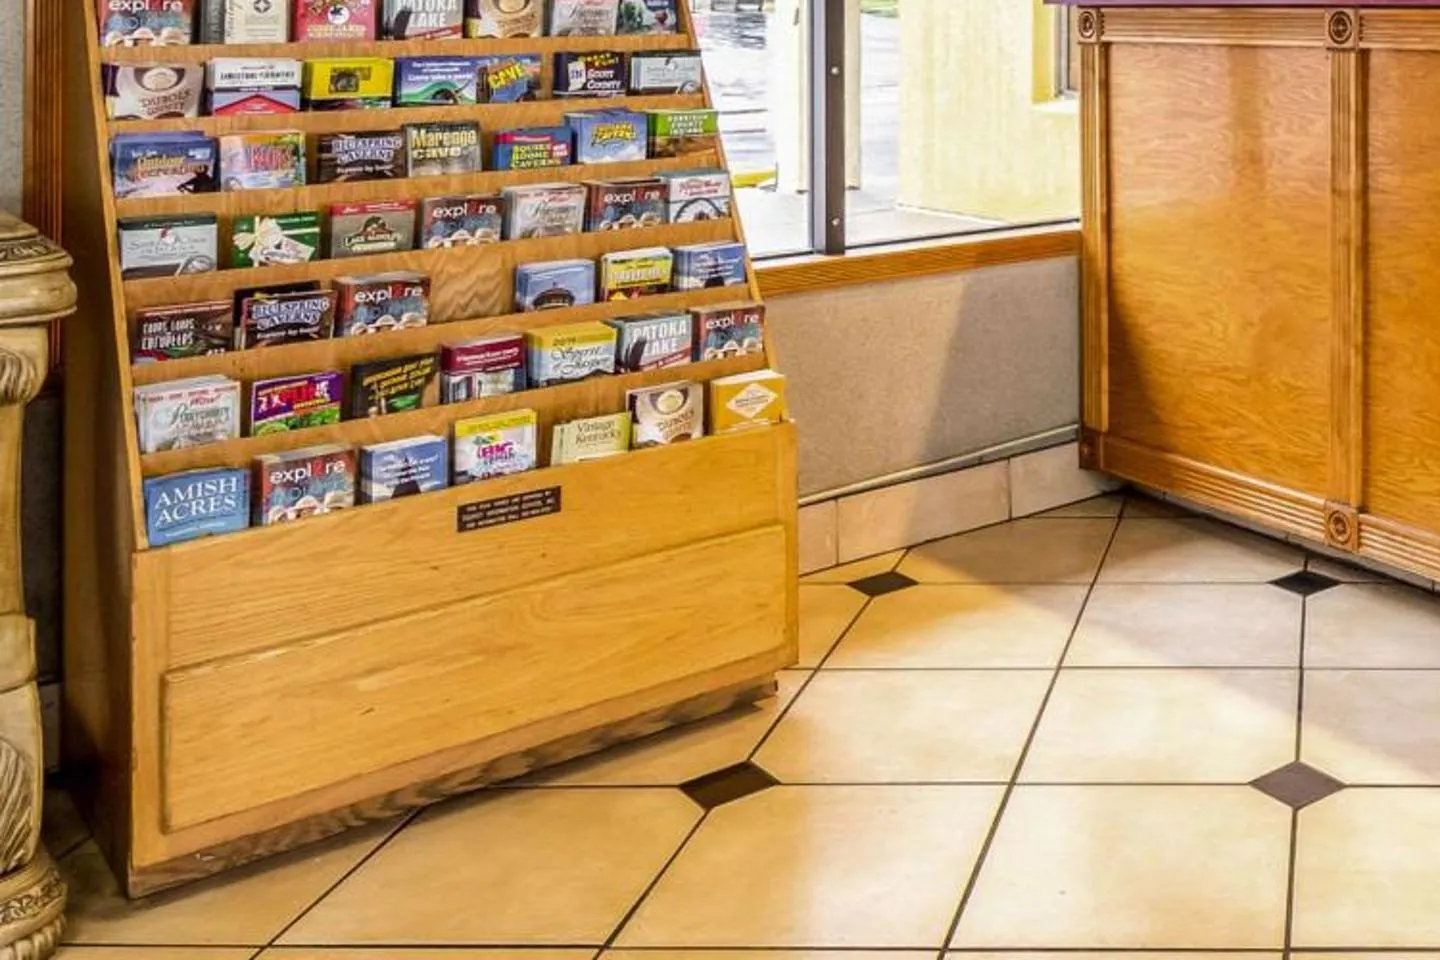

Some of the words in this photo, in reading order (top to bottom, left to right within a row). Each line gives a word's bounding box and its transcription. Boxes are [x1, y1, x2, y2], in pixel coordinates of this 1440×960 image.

[411, 128, 477, 148] Marengo
[632, 320, 688, 342] PATOKA
[155, 477, 238, 510] AMISH
[155, 495, 237, 529] ACRES
